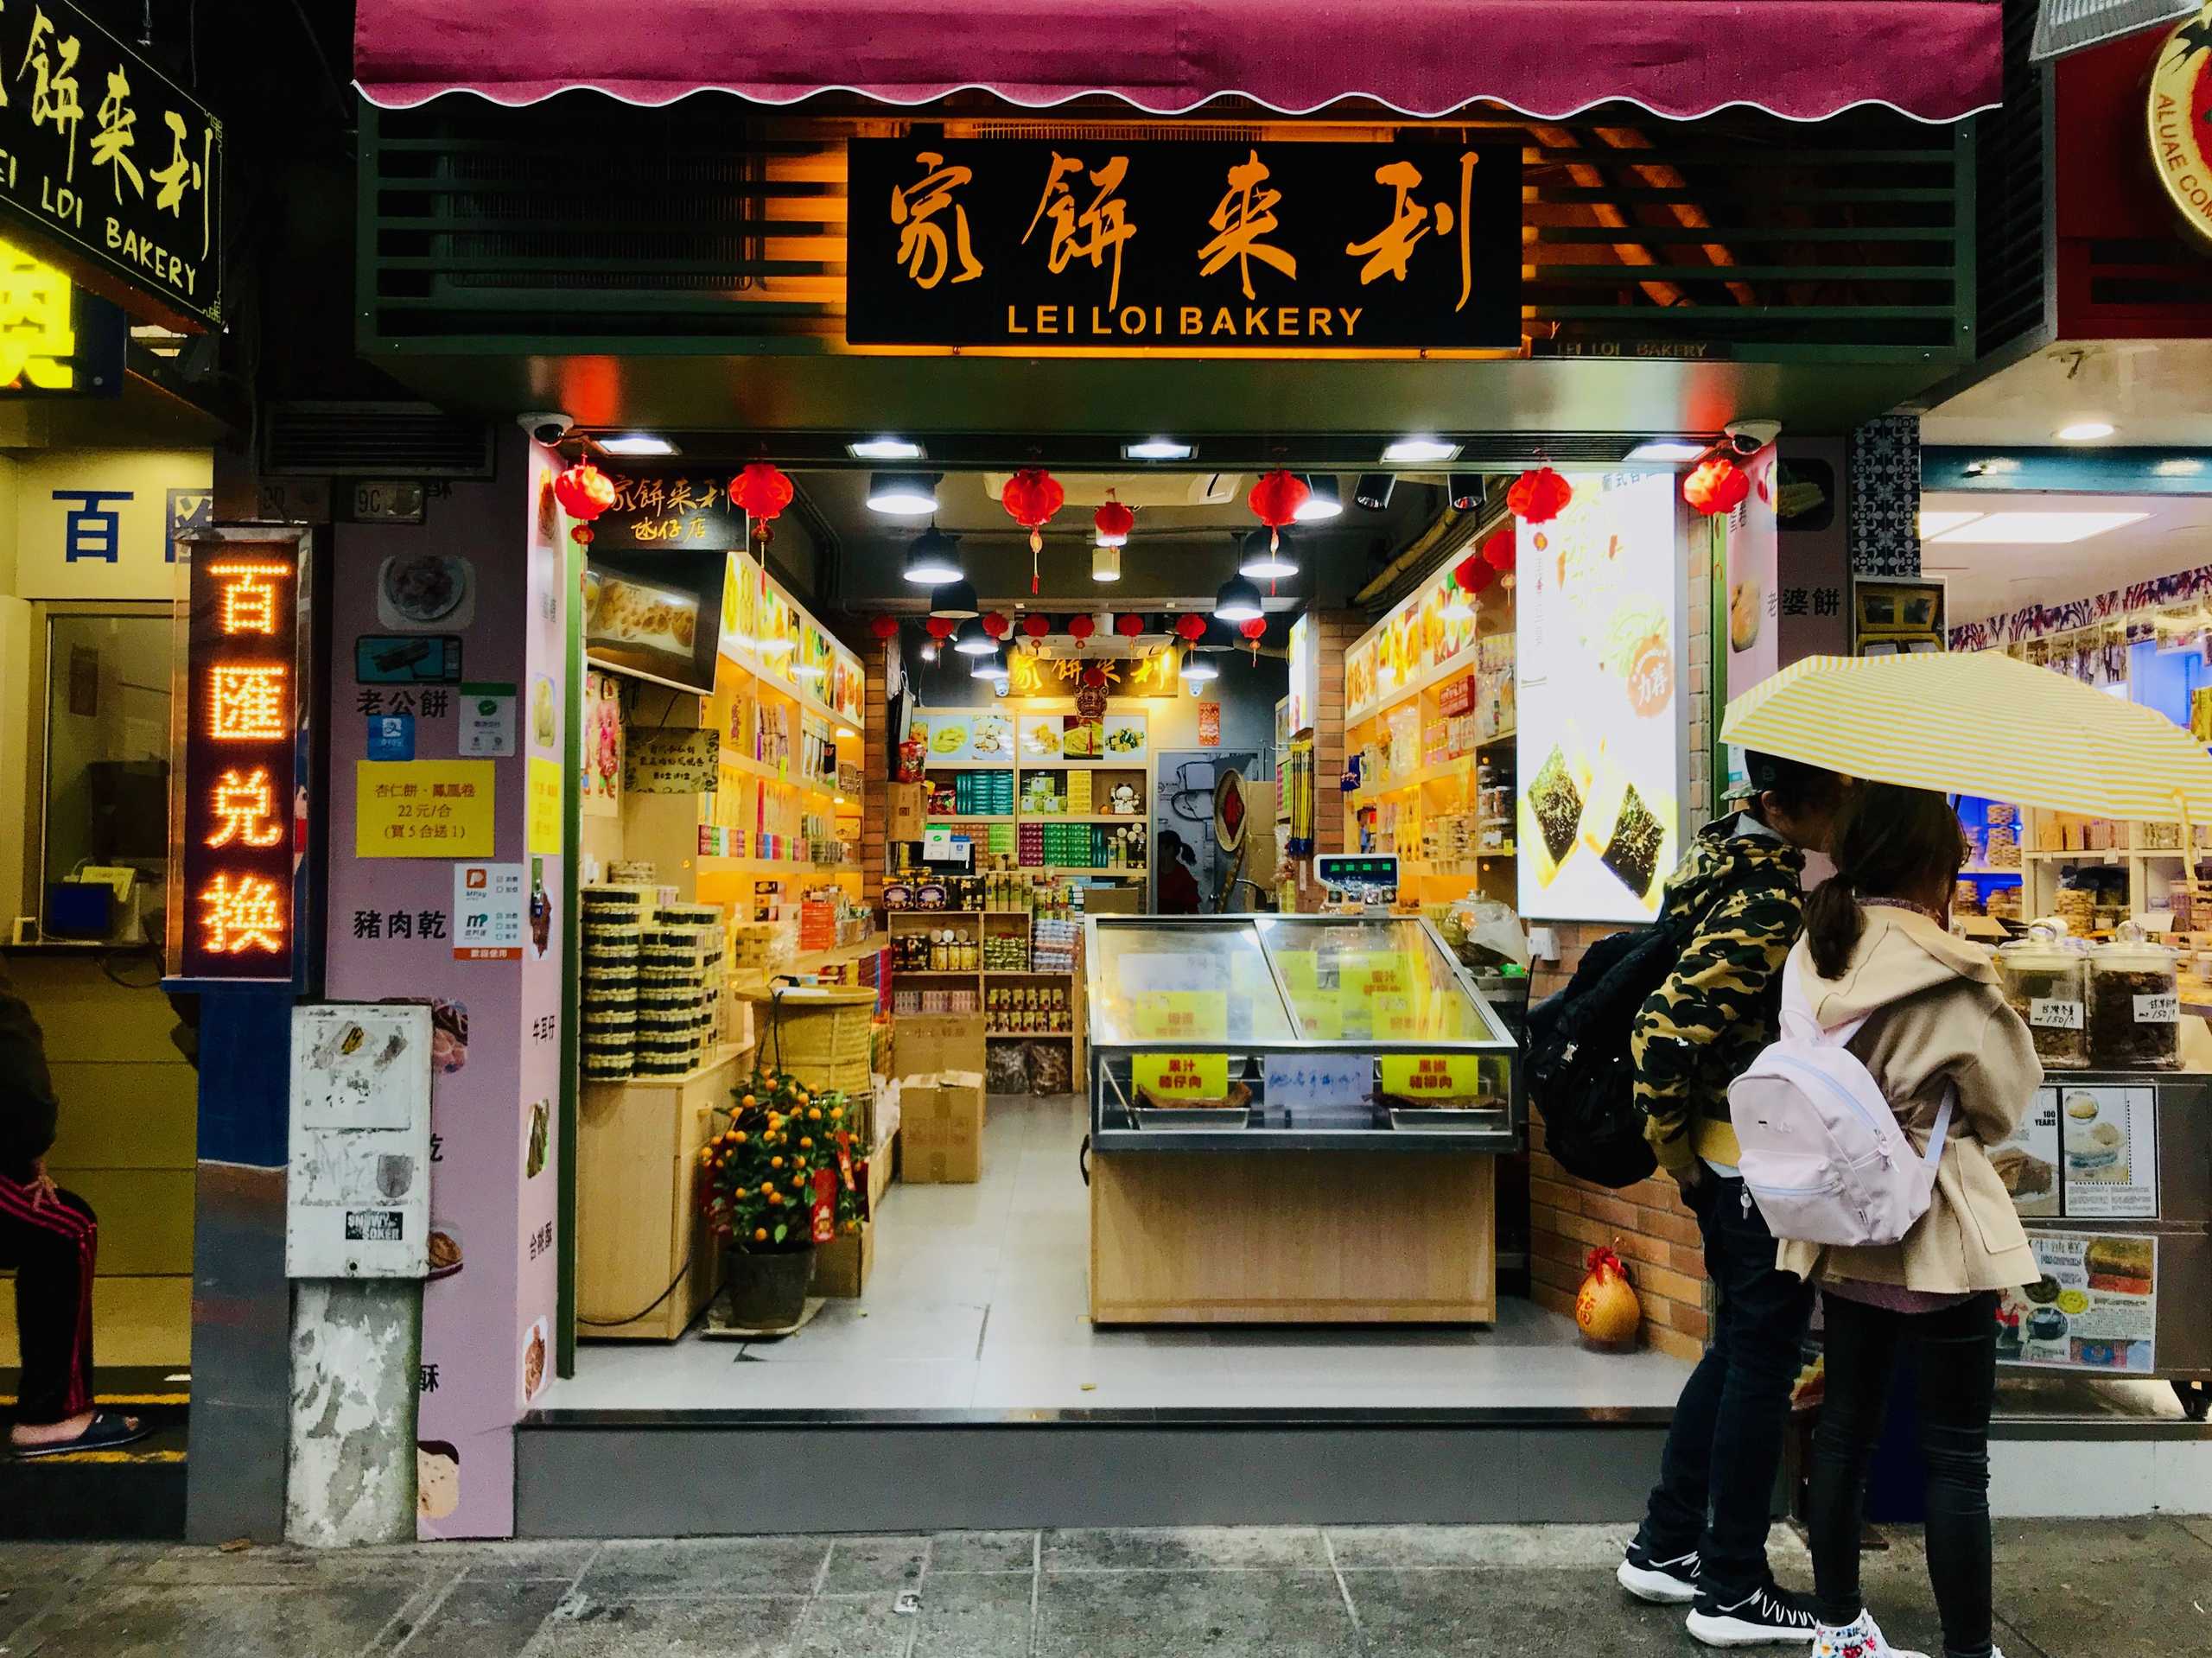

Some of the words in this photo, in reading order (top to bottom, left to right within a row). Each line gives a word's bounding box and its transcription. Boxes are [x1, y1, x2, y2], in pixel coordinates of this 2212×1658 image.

[105, 217, 197, 296] BAKERY
[1007, 306, 1075, 334] LEI
[1092, 306, 1163, 335] LOI
[1179, 306, 1363, 335] BAKERY
[2034, 1118, 2056, 1127] YEARS
